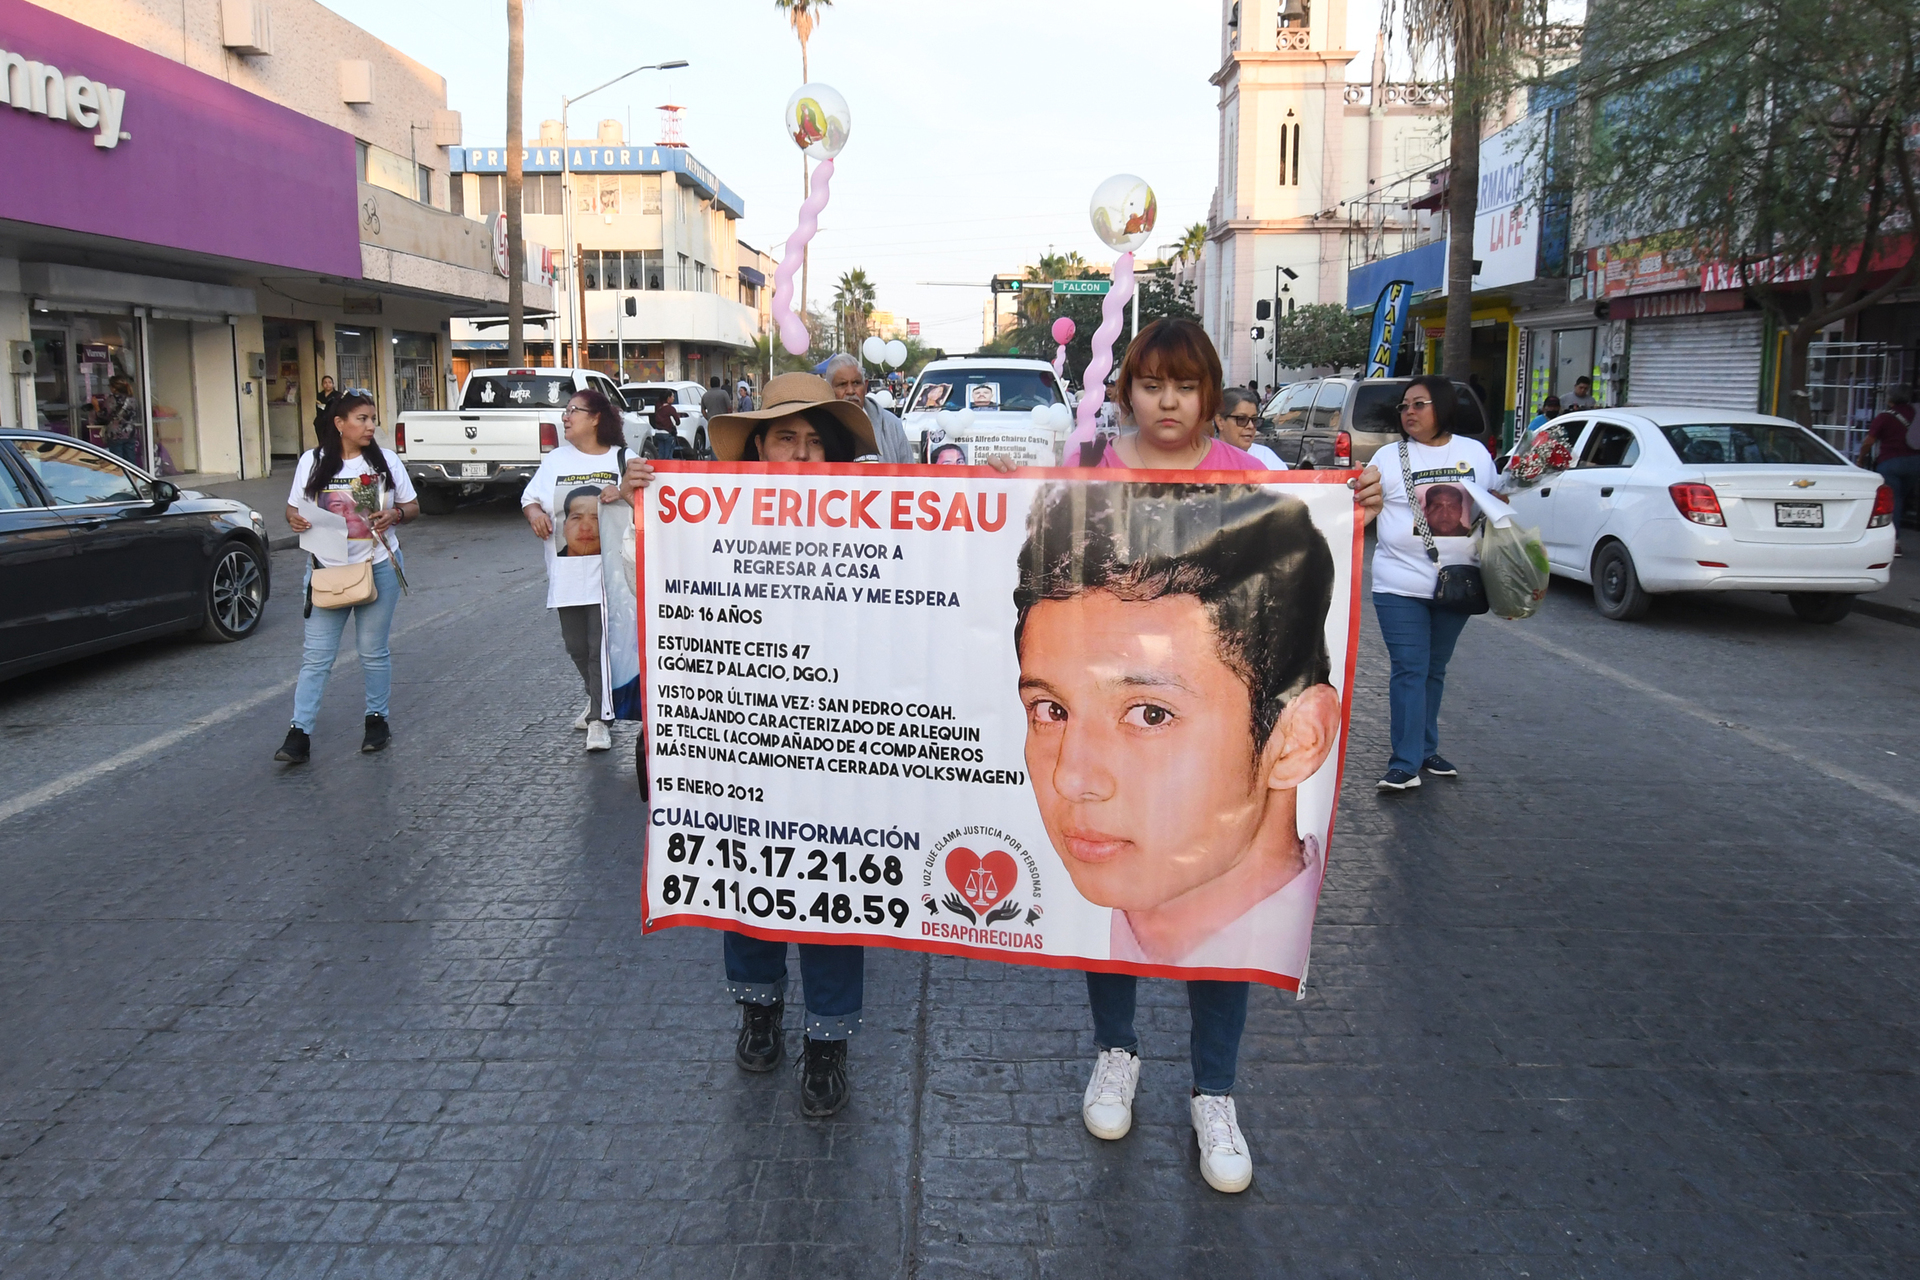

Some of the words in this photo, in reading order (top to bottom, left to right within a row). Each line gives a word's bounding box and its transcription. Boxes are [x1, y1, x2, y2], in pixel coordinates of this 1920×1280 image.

[1490, 214, 1504, 252] LA
[1507, 207, 1524, 247] FE
[1063, 283, 1100, 291] FALCON
[1634, 291, 1706, 318] VITRINAS
[975, 435, 1000, 443] Alfredo
[1028, 435, 1049, 445] Castro
[658, 486, 741, 524] SOY
[753, 489, 881, 528] ERICK
[891, 491, 1006, 532] ESAU
[712, 539, 791, 555] AYUDAME
[796, 542, 828, 557] POR
[833, 543, 887, 559] FAVOR
[892, 545, 903, 560] A
[734, 559, 816, 576] REGRESAR
[821, 563, 832, 577] A
[836, 563, 880, 579] CASA
[666, 579, 680, 593] MI
[684, 580, 741, 597] FAMILIA
[745, 583, 767, 598] ME
[771, 582, 847, 602] EXTRAÑA
[852, 588, 863, 602] Y
[867, 588, 891, 603] ME
[895, 590, 960, 607] ESPERA
[659, 604, 694, 620] EDAD:
[699, 607, 713, 621] 16
[717, 605, 762, 624] AÑOS
[658, 636, 741, 655] ESTUDIANTE
[744, 642, 788, 658] CETIS
[792, 645, 810, 659] 47
[658, 655, 713, 674] (GÓMEZ
[718, 661, 789, 682] PALACIO,
[794, 666, 838, 683] DGO.)
[658, 685, 694, 700] VISTO
[698, 688, 723, 703] POR
[728, 687, 778, 708] ÚLTIMA
[781, 695, 814, 710] VEZ:
[818, 698, 848, 713] SAN
[853, 700, 903, 716] PEDRO
[906, 704, 955, 720] COAH.
[657, 704, 745, 724] TRABAJANDO
[748, 713, 874, 735] CARACTERIZADO
[877, 722, 895, 736] DE
[898, 724, 979, 742] ARLEQUIN
[657, 724, 672, 736] DE
[677, 724, 720, 742] TELCEL
[724, 730, 834, 751] (ACOMPAÑADO
[837, 739, 855, 753] DE
[858, 741, 867, 755] 4
[870, 741, 984, 763] COMPAÑEROS
[656, 740, 686, 757] MÁS
[688, 745, 706, 758] EN
[709, 747, 736, 763] UNA
[738, 751, 825, 771] CAMIONETA
[828, 759, 899, 777] CERRADA
[902, 764, 1024, 785] VOLKSWAGEN)
[656, 778, 673, 791] 15
[678, 778, 724, 796] ENERO
[728, 784, 763, 802] 2012
[652, 808, 760, 837] CUALQUIER
[766, 820, 919, 850] INFORMACIÓN
[668, 833, 903, 886] 87.15.17.21.68
[926, 850, 938, 867] QUE
[935, 829, 962, 851] CLAMA
[964, 826, 1001, 838] JUSTICIA
[1004, 834, 1021, 851] POR
[1020, 850, 1041, 897] PERSONAS
[663, 874, 909, 928] 87.11.05.48.59
[922, 922, 1042, 949] DESAPARECIDAS
